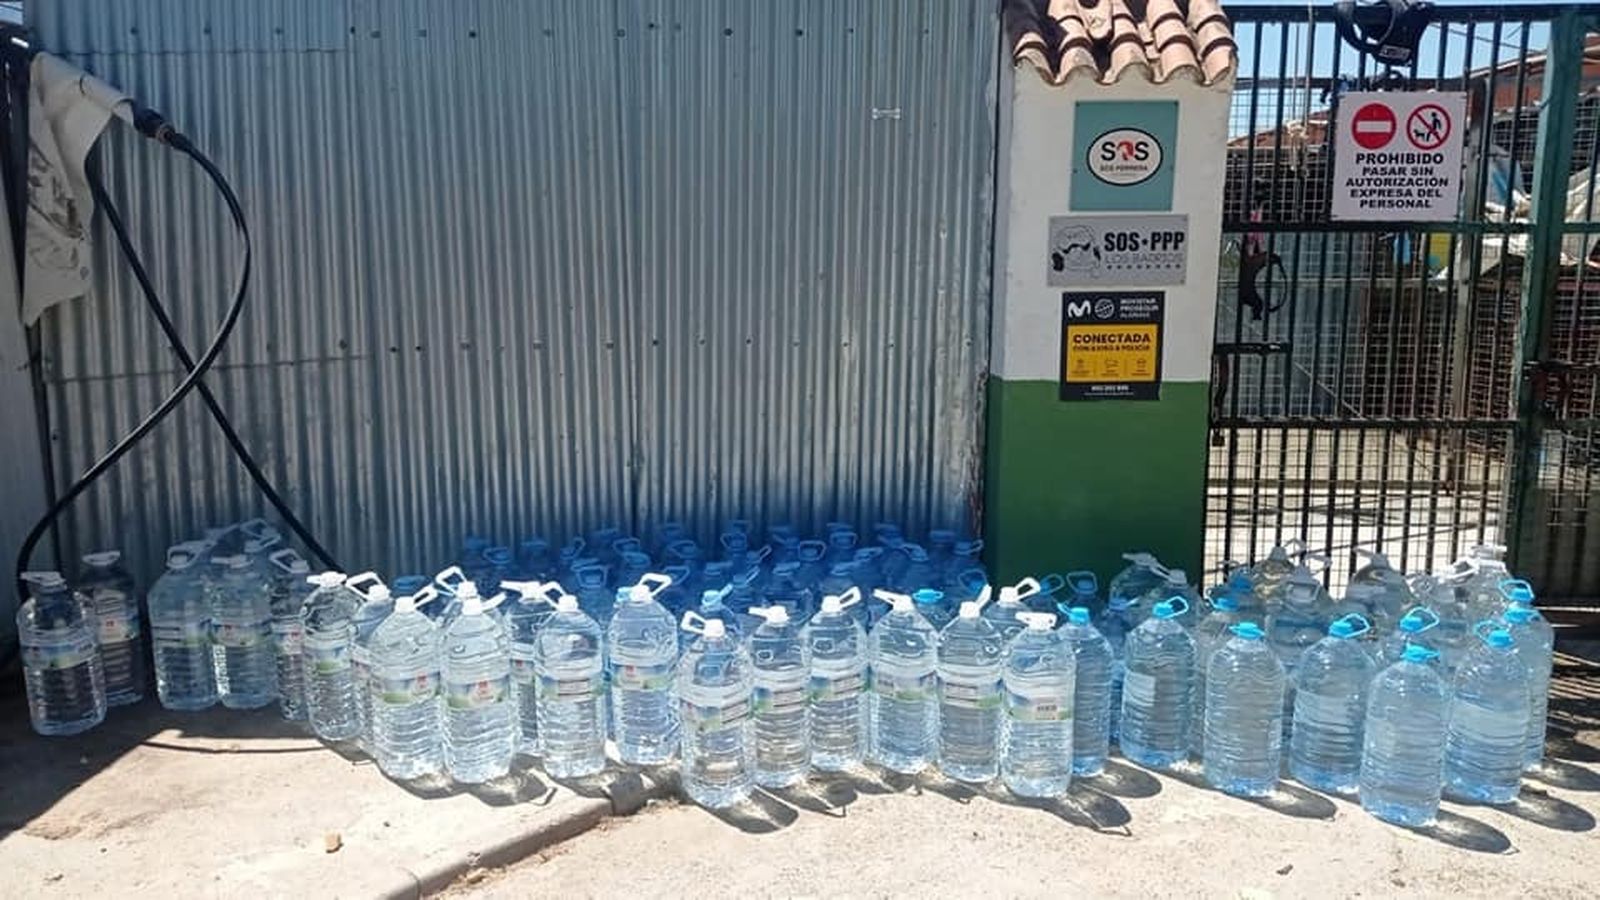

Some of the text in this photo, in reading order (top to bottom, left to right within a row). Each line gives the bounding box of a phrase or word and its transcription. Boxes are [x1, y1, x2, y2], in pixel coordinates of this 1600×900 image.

[1356, 153, 1444, 165] PROHIBIDO
[1362, 167, 1434, 176] PASAR SIN
[1350, 188, 1442, 198] EXPRESA DEL
[1360, 199, 1433, 208] PERSONAL
[1104, 231, 1185, 252] SOS PPP
[1073, 333, 1151, 344] CONECTADA
